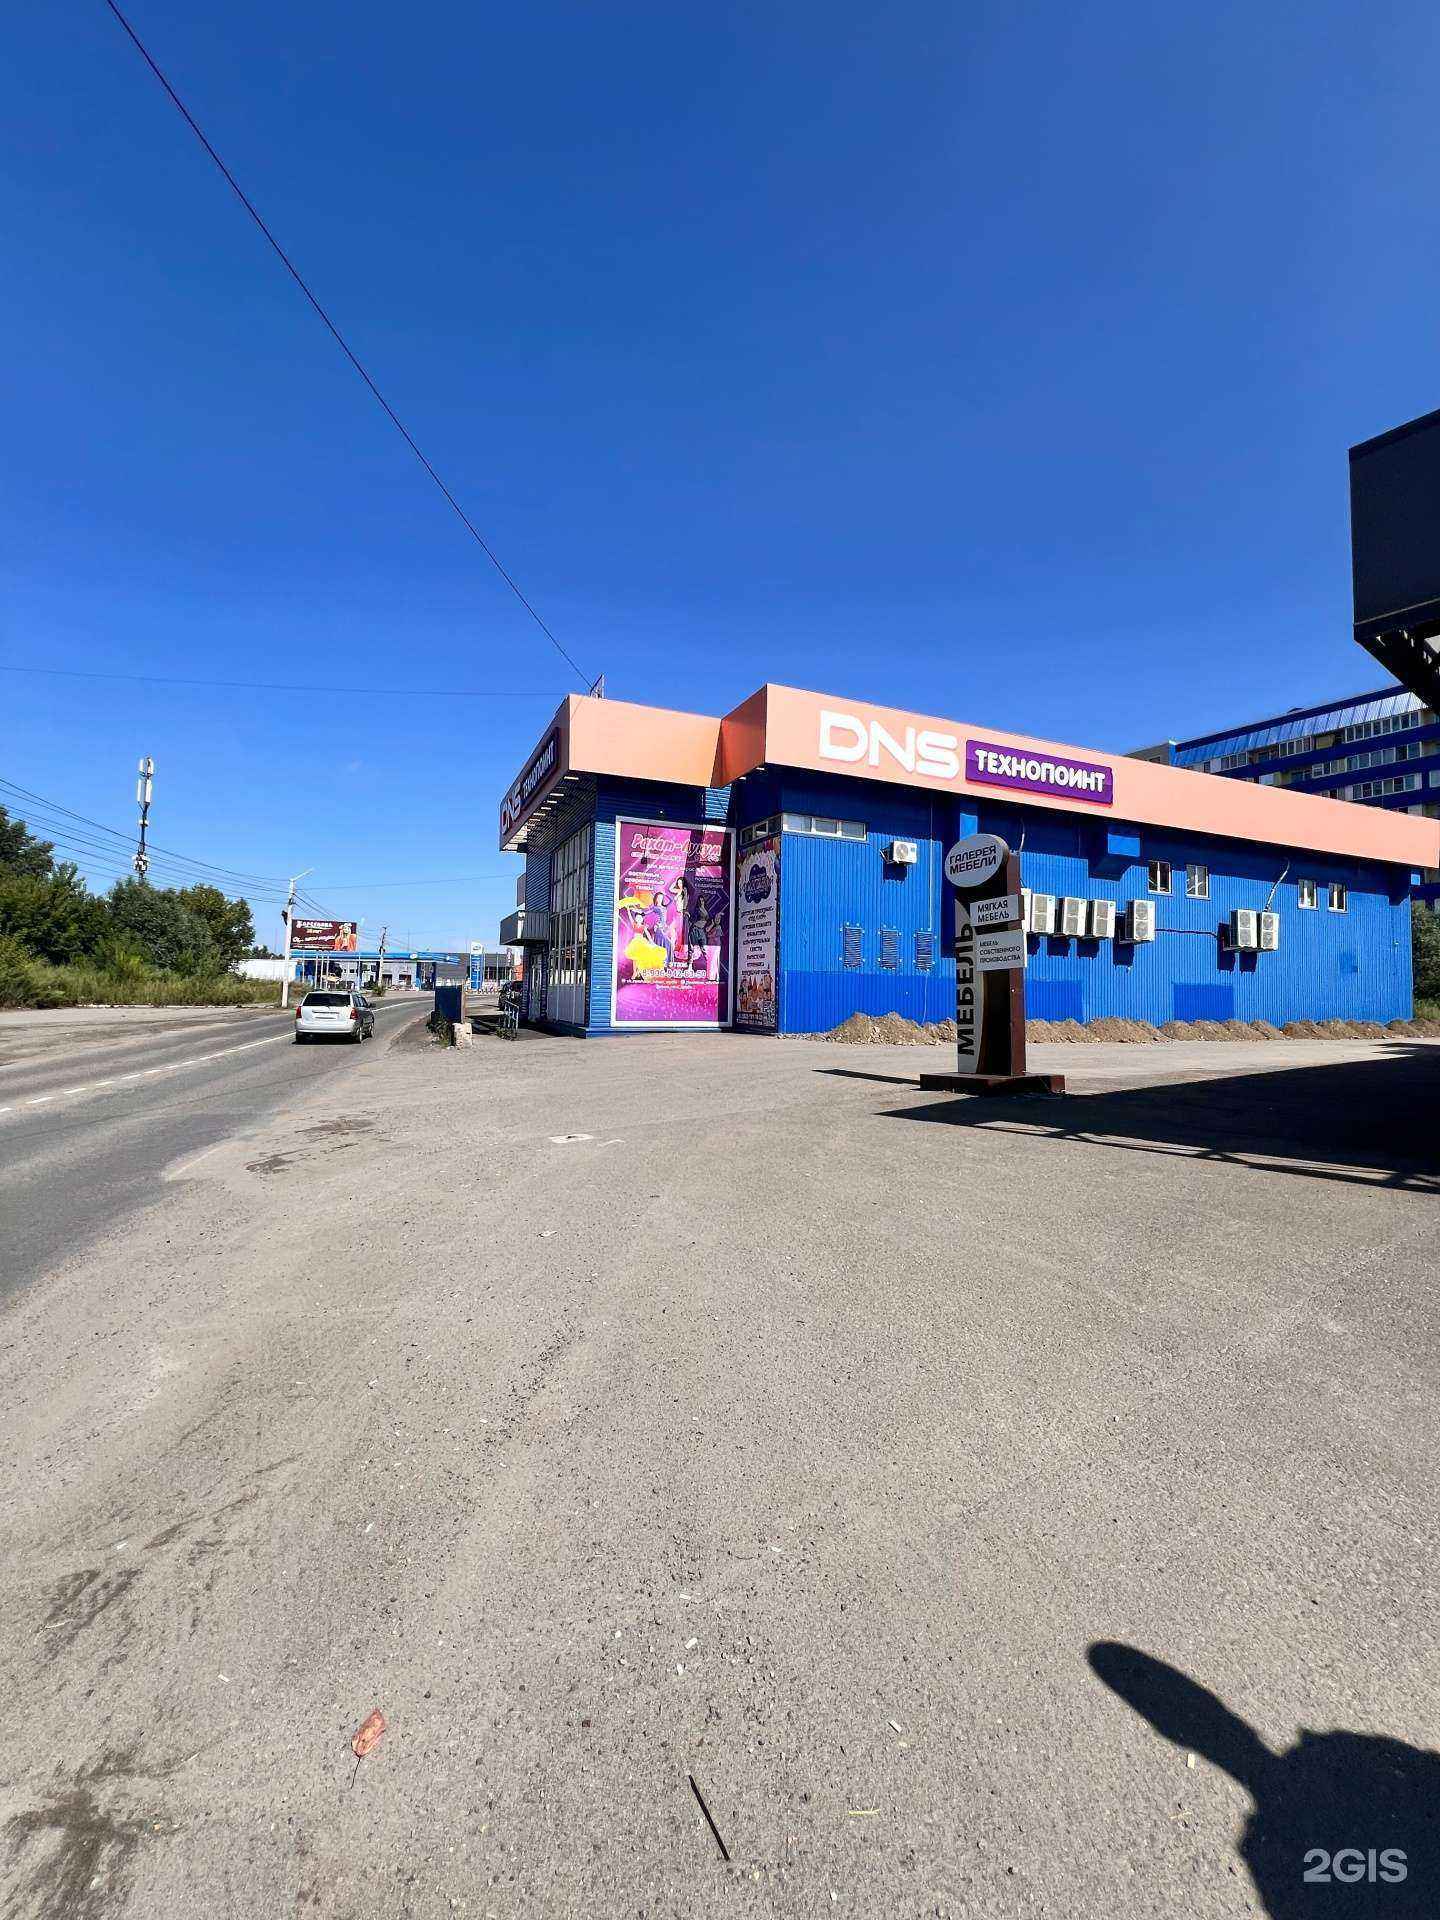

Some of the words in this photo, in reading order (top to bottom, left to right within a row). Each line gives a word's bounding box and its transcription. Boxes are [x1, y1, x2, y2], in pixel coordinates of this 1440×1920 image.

[819, 709, 960, 780] DNS
[974, 749, 1106, 793] ТЕХНОПОИНТ
[501, 782, 521, 835] DNS
[950, 845, 997, 864] ГАЛЕРЕЯ
[950, 855, 997, 875] МЕБЕЛИ
[977, 900, 1008, 913] МЯГКАЯ
[977, 910, 1010, 923] МЕБЕЛЬ
[957, 923, 975, 1056] МЕБЕЛЬ
